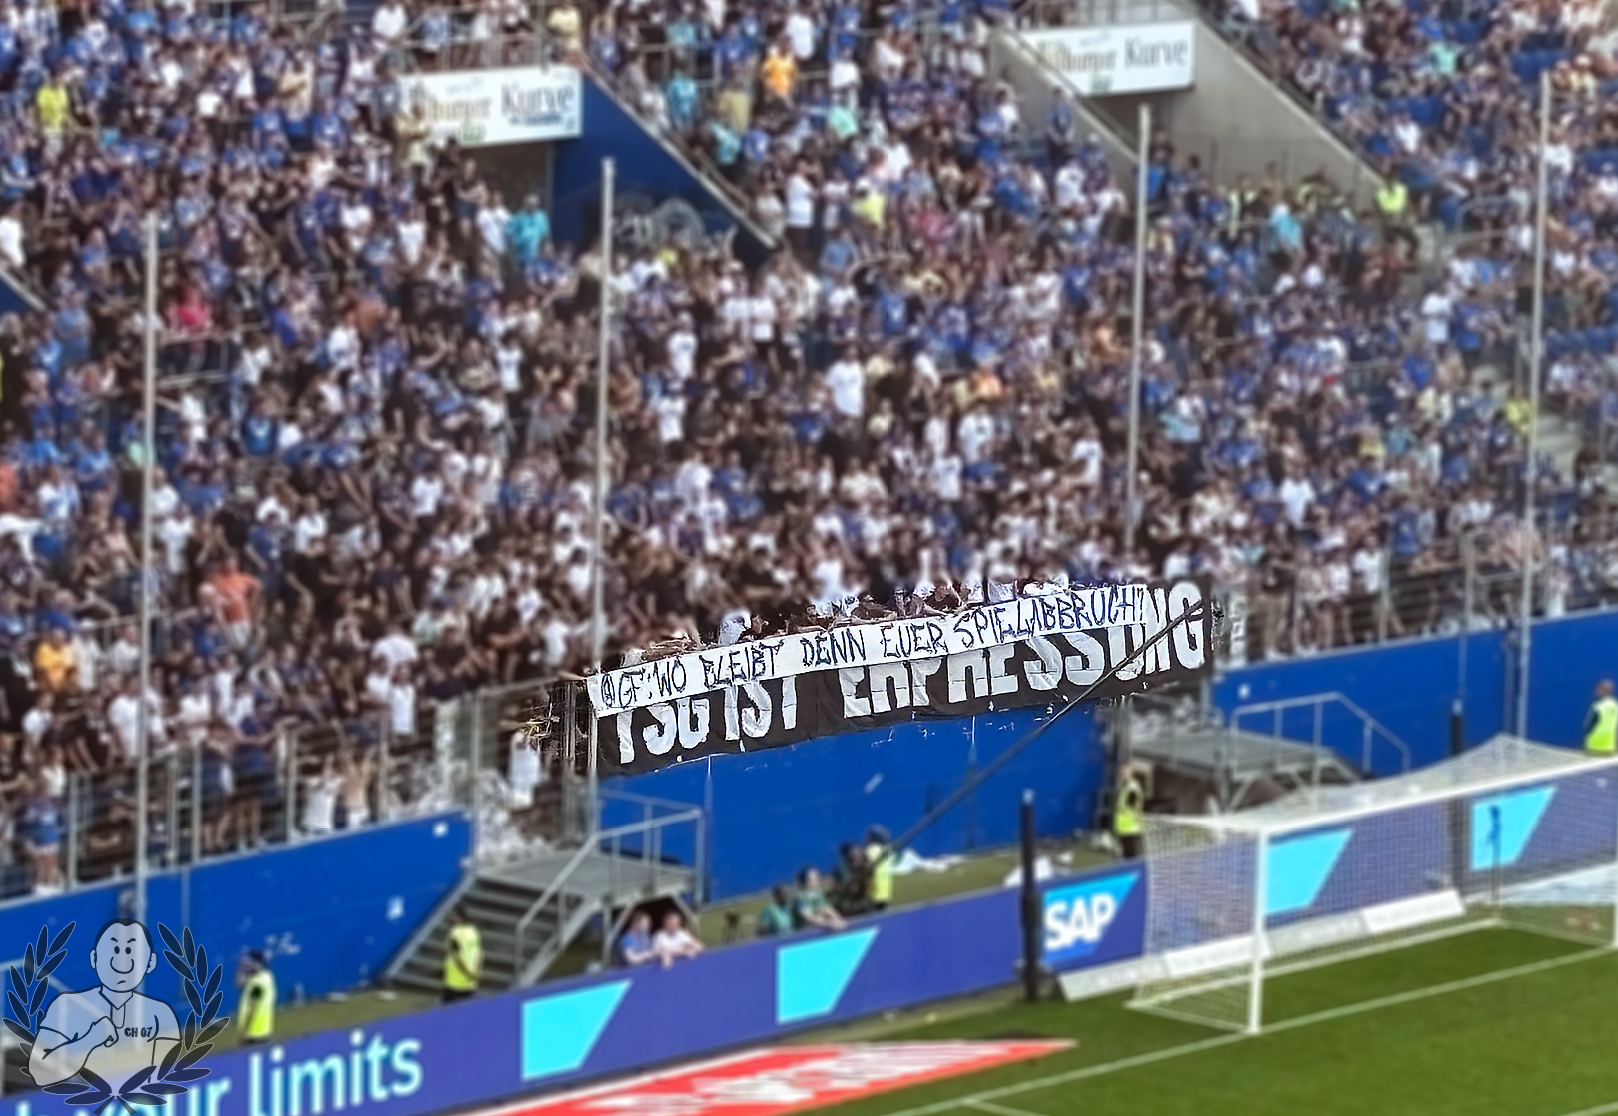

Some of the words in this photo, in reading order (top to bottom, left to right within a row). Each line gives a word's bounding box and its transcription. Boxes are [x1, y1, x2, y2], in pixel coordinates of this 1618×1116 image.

[699, 640, 785, 691] BLEIBT
[800, 628, 867, 667] DENN
[880, 622, 950, 659] EUER
[1045, 893, 1116, 949] SAP
[249, 1029, 422, 1115] limits
